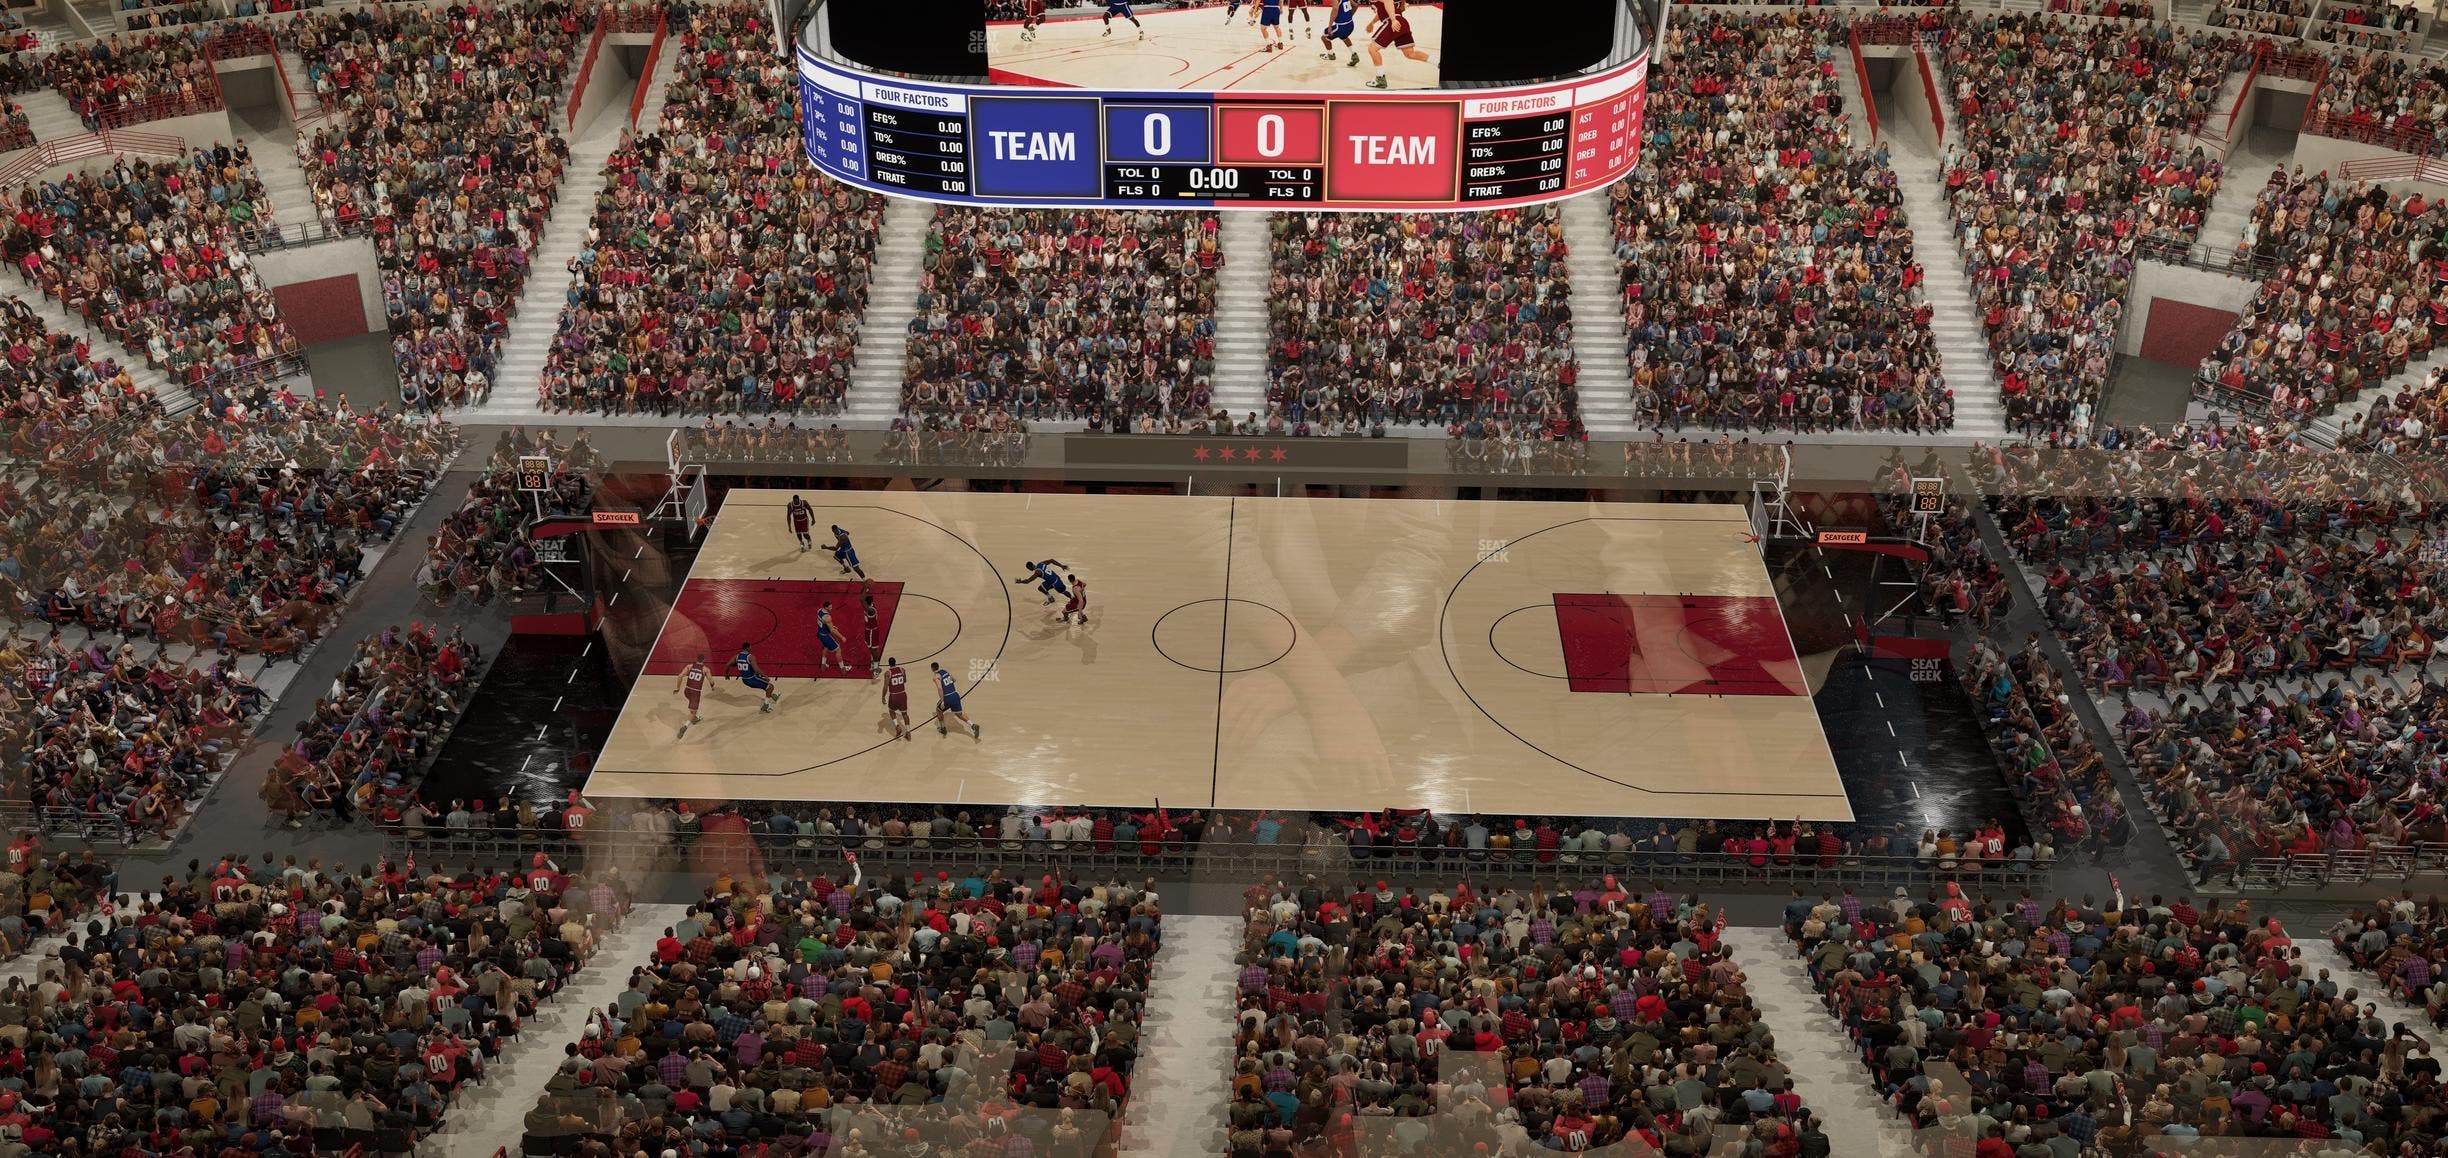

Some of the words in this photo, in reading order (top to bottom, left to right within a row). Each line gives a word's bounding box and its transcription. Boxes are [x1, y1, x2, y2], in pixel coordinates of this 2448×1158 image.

[875, 88, 901, 106] FOUR
[904, 91, 949, 108] FACTORS
[1479, 100, 1509, 114] FOUR
[1511, 96, 1556, 111] FACTORS
[838, 103, 854, 117] 0.00
[1579, 112, 1592, 124] AST
[1613, 100, 1627, 115] 0.00
[839, 121, 856, 135] 0.00
[872, 112, 897, 126] EFG%
[938, 121, 962, 134] 0.00
[1472, 126, 1501, 138] EFG%
[1543, 118, 1564, 132] 0.00
[1611, 118, 1625, 133] 0.00
[874, 131, 893, 144] TO%
[939, 141, 963, 154] 0.00
[1143, 113, 1171, 156] 0
[1257, 114, 1285, 157] 0
[1610, 136, 1623, 151] 0.00
[841, 139, 857, 153] 0.00
[988, 130, 1076, 161] TEAM
[1348, 135, 1436, 165] TEAM
[1471, 147, 1493, 158] TO%
[1542, 138, 1563, 152] 0.00
[842, 157, 859, 171] 0.00
[876, 151, 906, 166] OREB%
[941, 161, 964, 174] 0.00
[1470, 165, 1505, 178] OREB%
[1540, 158, 1561, 172] 0.00
[1575, 168, 1587, 179] STL
[1608, 154, 1622, 169] 0.00
[877, 170, 906, 185] FTRATE
[942, 180, 965, 193] 0.00
[1117, 168, 1145, 178] TOL
[1151, 167, 1160, 179] 0
[1189, 168, 1238, 189] 0:00
[1269, 170, 1296, 180] TOL
[1302, 169, 1311, 181] 0
[1118, 186, 1143, 196] FLS
[1151, 184, 1160, 196] 0
[1269, 187, 1294, 197] FLS
[1302, 186, 1311, 198] 0
[1469, 185, 1502, 197] FTRATE
[1539, 177, 1560, 191] 0.00
[525, 475, 541, 488] 88
[1920, 497, 1936, 510] 88
[689, 671, 702, 681] 00
[891, 676, 904, 686] 00
[569, 814, 583, 827] 00
[1988, 838, 2002, 853] 00
[9, 848, 21, 863] 00
[533, 877, 549, 891] 00
[429, 1053, 447, 1073] 00
[1569, 1130, 1587, 1151] 00
